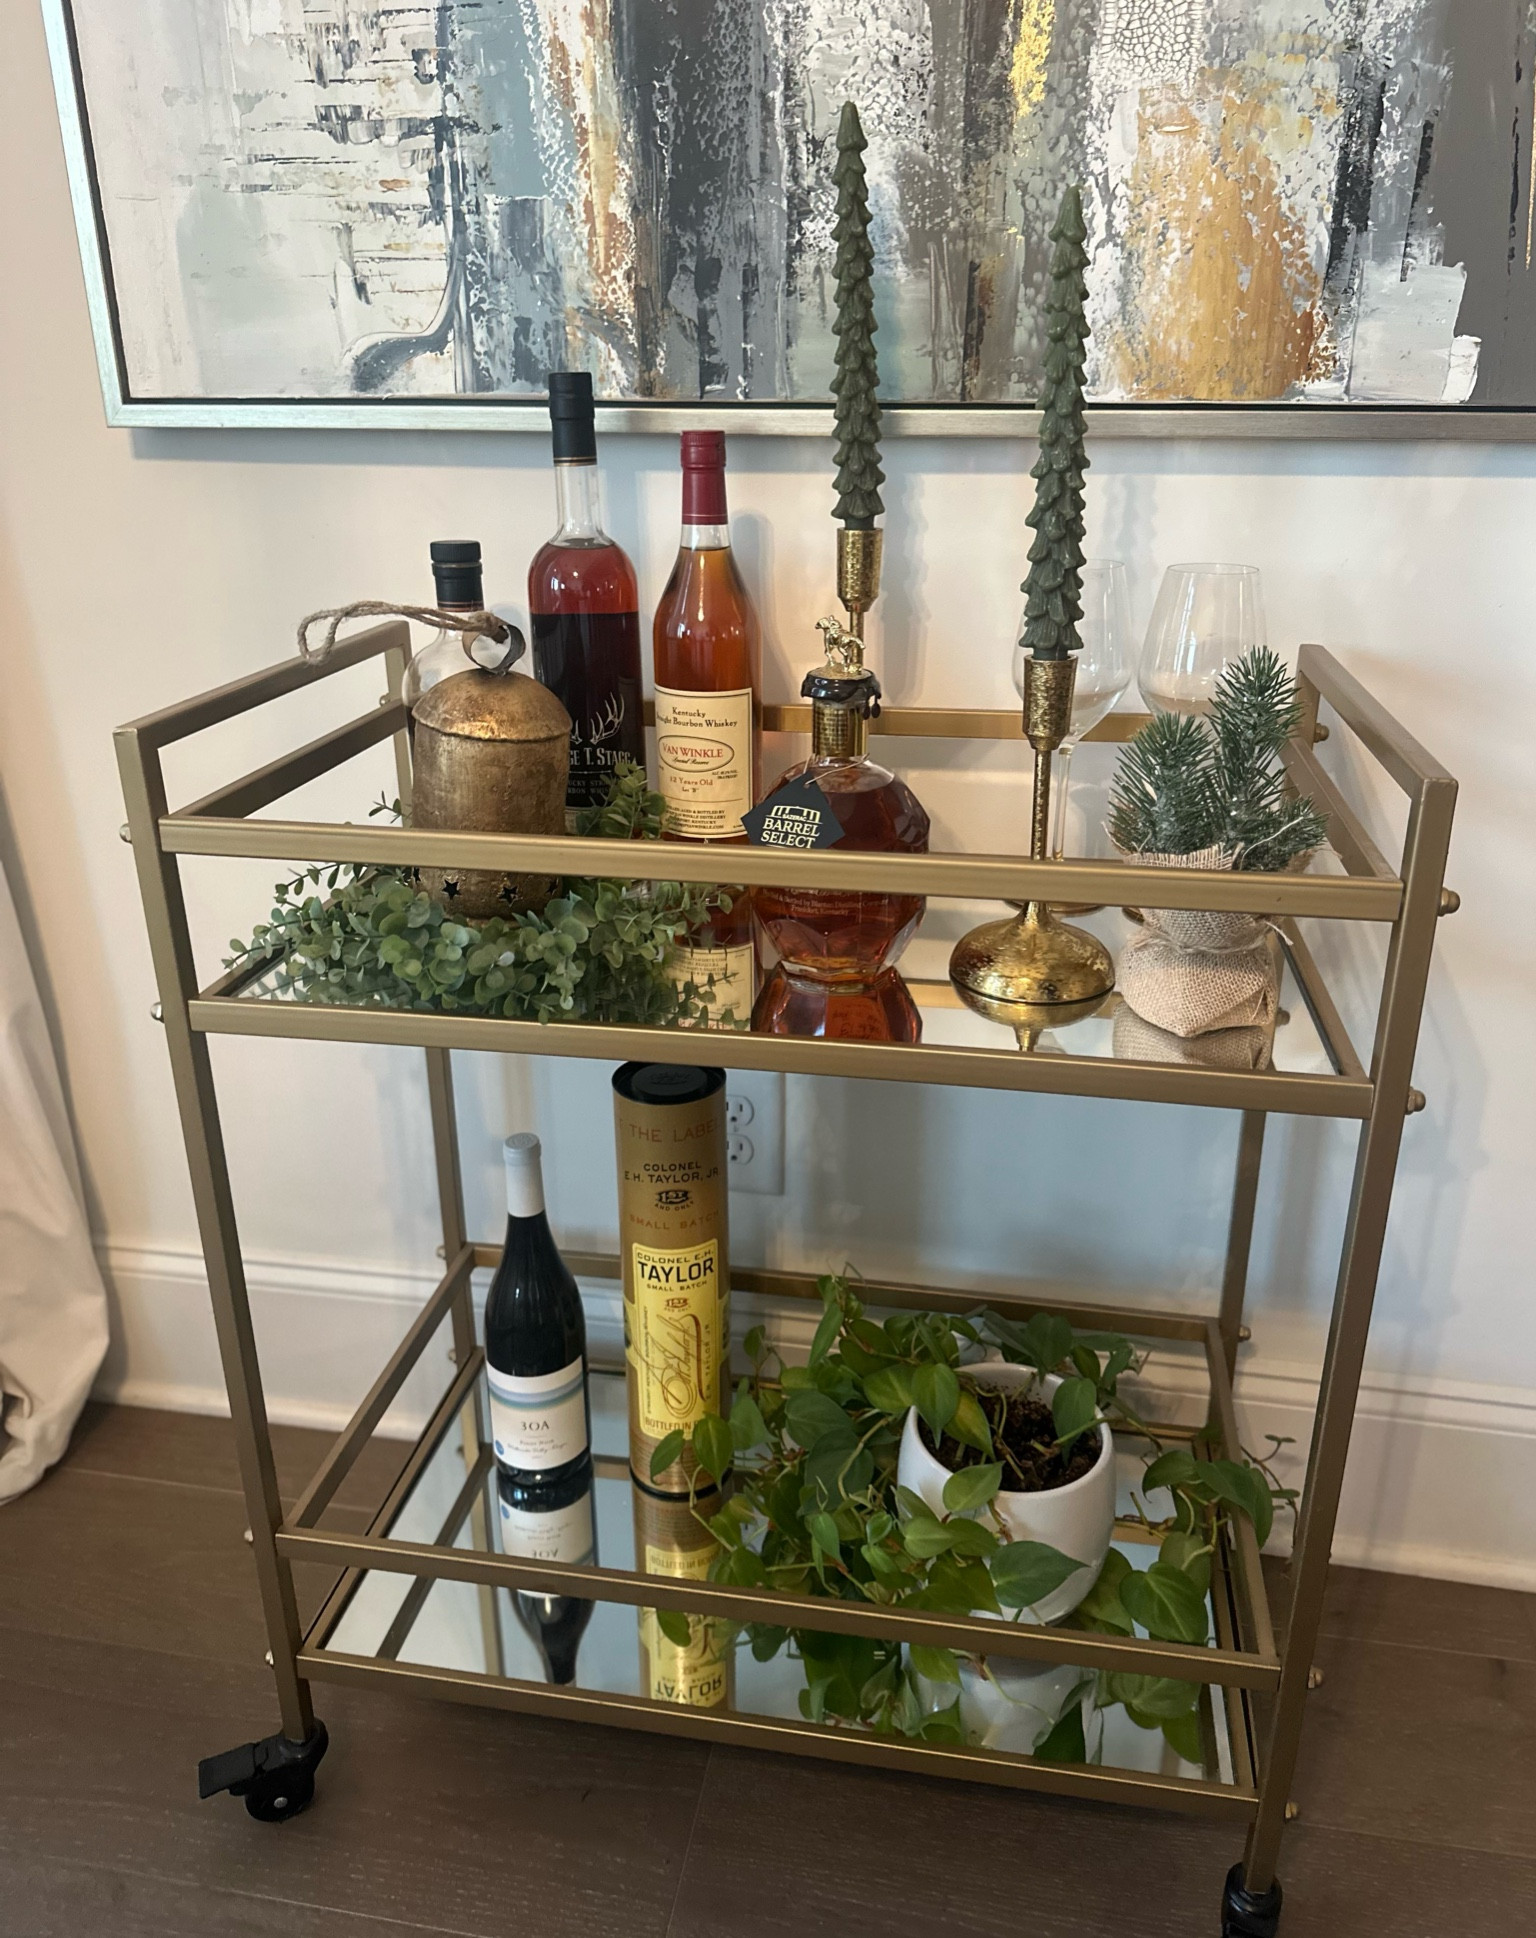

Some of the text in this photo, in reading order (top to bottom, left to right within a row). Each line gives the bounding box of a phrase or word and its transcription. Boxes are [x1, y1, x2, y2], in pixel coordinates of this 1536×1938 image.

[672, 707, 706, 718] Kentucky
[673, 717, 703, 728] Bourbon
[705, 720, 738, 728] Whiskey
[662, 743, 723, 758] VAN WINKLE
[679, 777, 698, 785] Years
[762, 818, 820, 836] BARREL
[760, 830, 816, 848] SELECT
[629, 1124, 662, 1142] THE
[644, 1162, 701, 1172] COLONEL
[648, 1172, 703, 1183] TAYLOR,
[654, 1201, 694, 1211] AND ONLY
[630, 1210, 719, 1230] SMALL BATCH
[638, 1250, 714, 1264] COLONEL E.H.
[638, 1257, 714, 1283] TAYLOR
[647, 1281, 707, 1292] SMALL BATCH
[646, 1417, 692, 1431] BOTTLED IN
